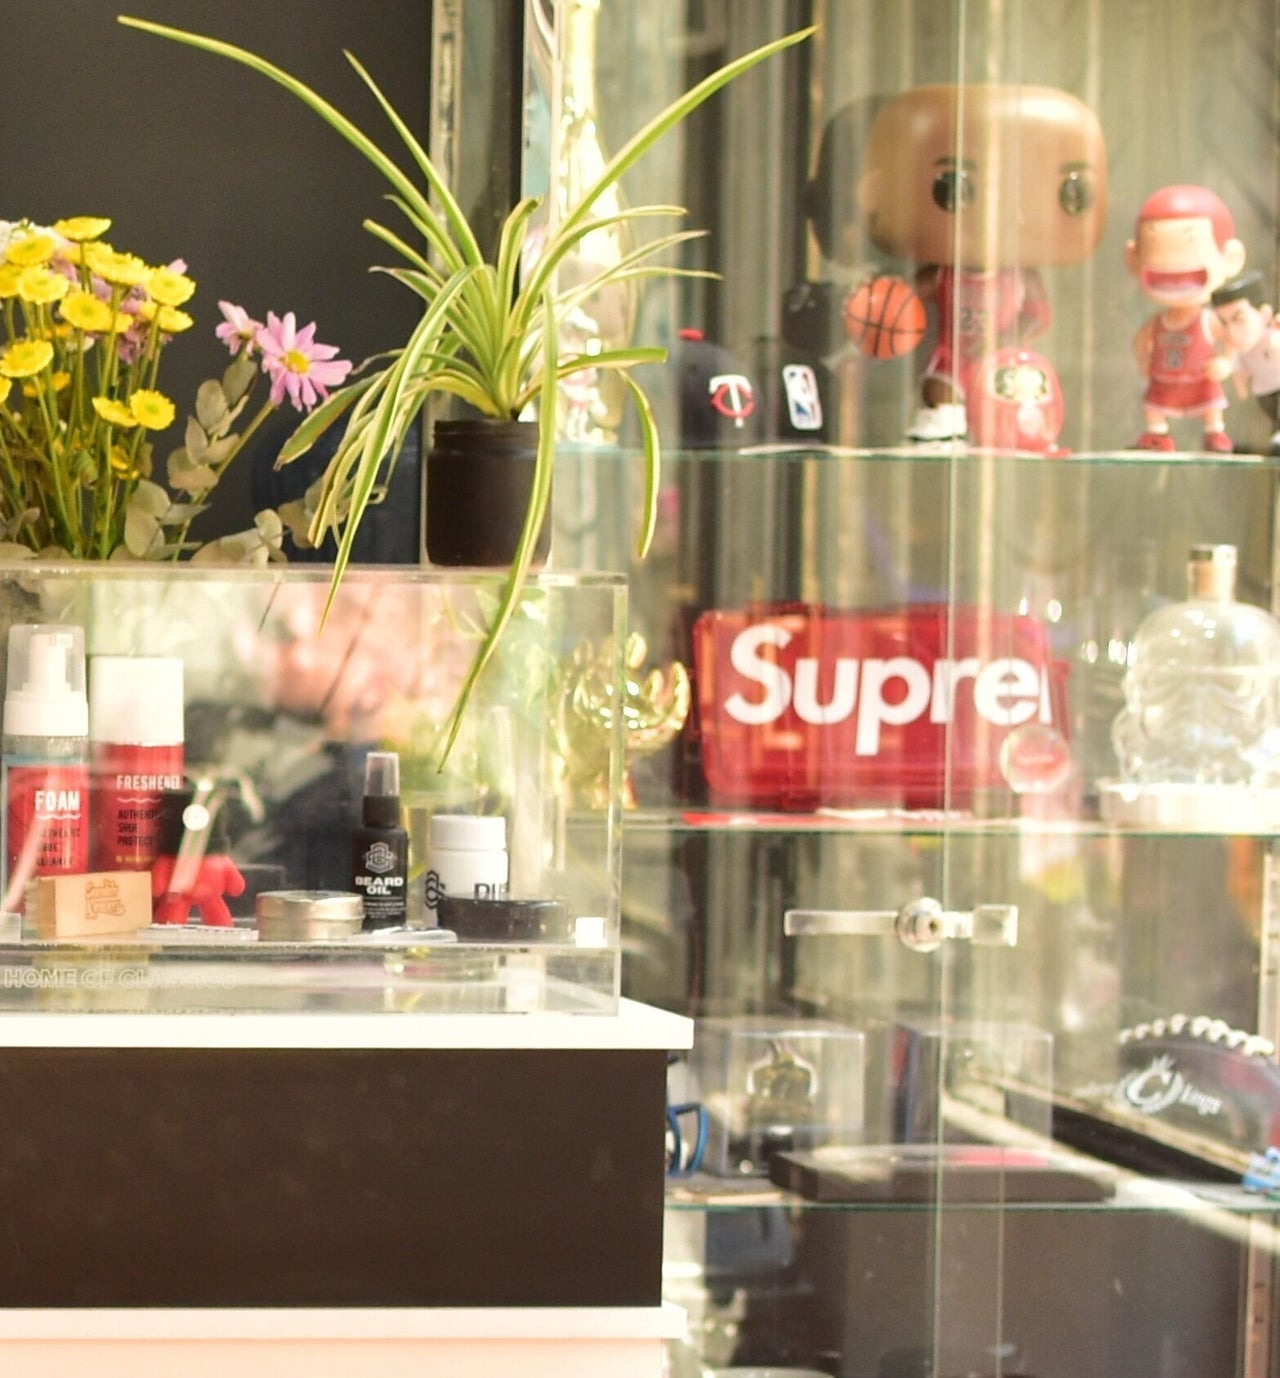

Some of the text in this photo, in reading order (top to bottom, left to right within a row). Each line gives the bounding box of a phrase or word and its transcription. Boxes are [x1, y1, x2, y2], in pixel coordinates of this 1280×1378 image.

[34, 789, 81, 812] FOAM
[354, 875, 404, 887] BEARD
[365, 885, 392, 895] OIL
[3, 968, 77, 988] HOME
